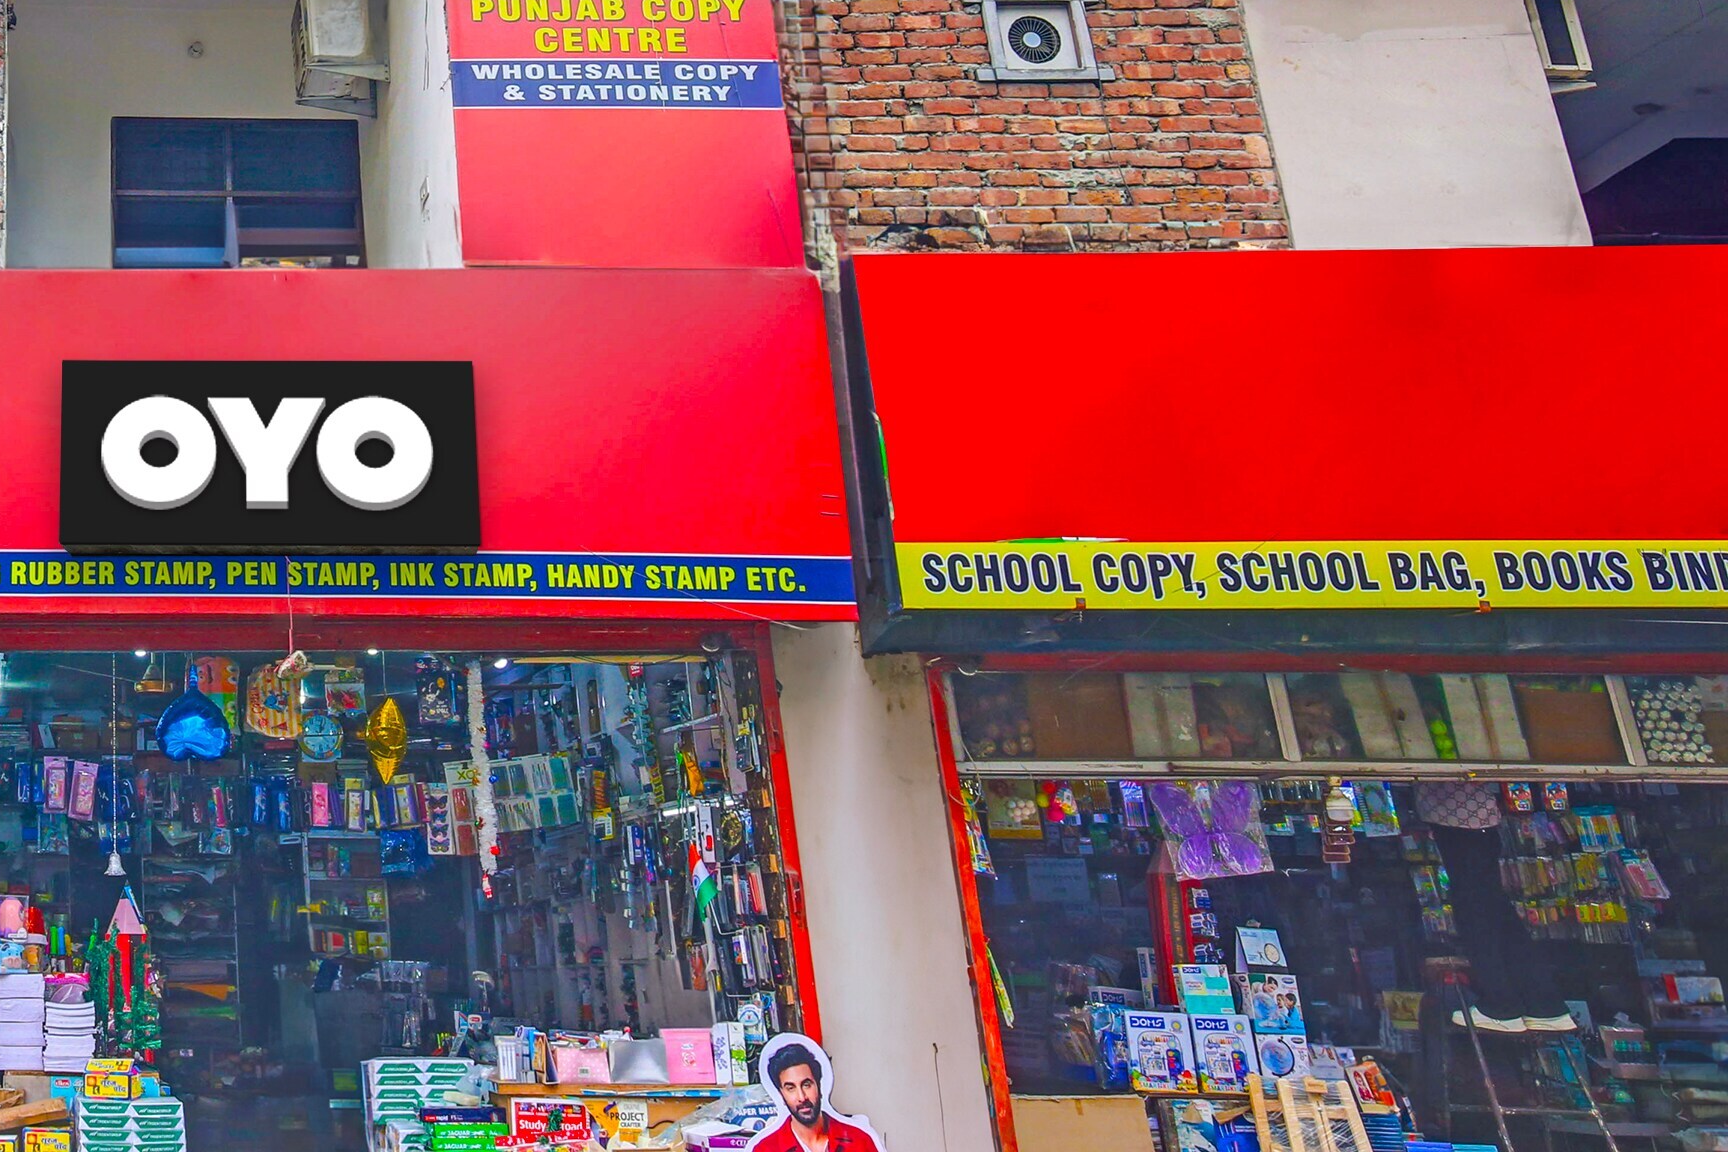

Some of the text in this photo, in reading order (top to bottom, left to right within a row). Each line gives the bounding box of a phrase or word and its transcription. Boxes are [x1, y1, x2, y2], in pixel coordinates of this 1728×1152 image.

[534, 27, 688, 53] CENTRE
[471, 63, 759, 81] WHOLESALE COPY
[503, 84, 731, 102] & STATIONERY
[100, 395, 433, 510] OYO
[11, 561, 114, 585] RUBBER
[125, 561, 216, 590] STAMP,
[227, 561, 277, 586] PEN
[287, 561, 380, 590] STAMP,
[389, 563, 435, 587] INK
[443, 563, 535, 592] STAMP,
[547, 564, 635, 589] HANDY
[645, 565, 735, 591] STAMP
[745, 567, 806, 592] ETC.
[922, 549, 1634, 600] SCHOOL COPY, SCHOOL BAG, BOOKS
[1130, 1017, 1164, 1028] DOMS
[1196, 1019, 1228, 1030] DOMS
[519, 1119, 546, 1132] Study
[610, 1112, 645, 1121] PROJECT
